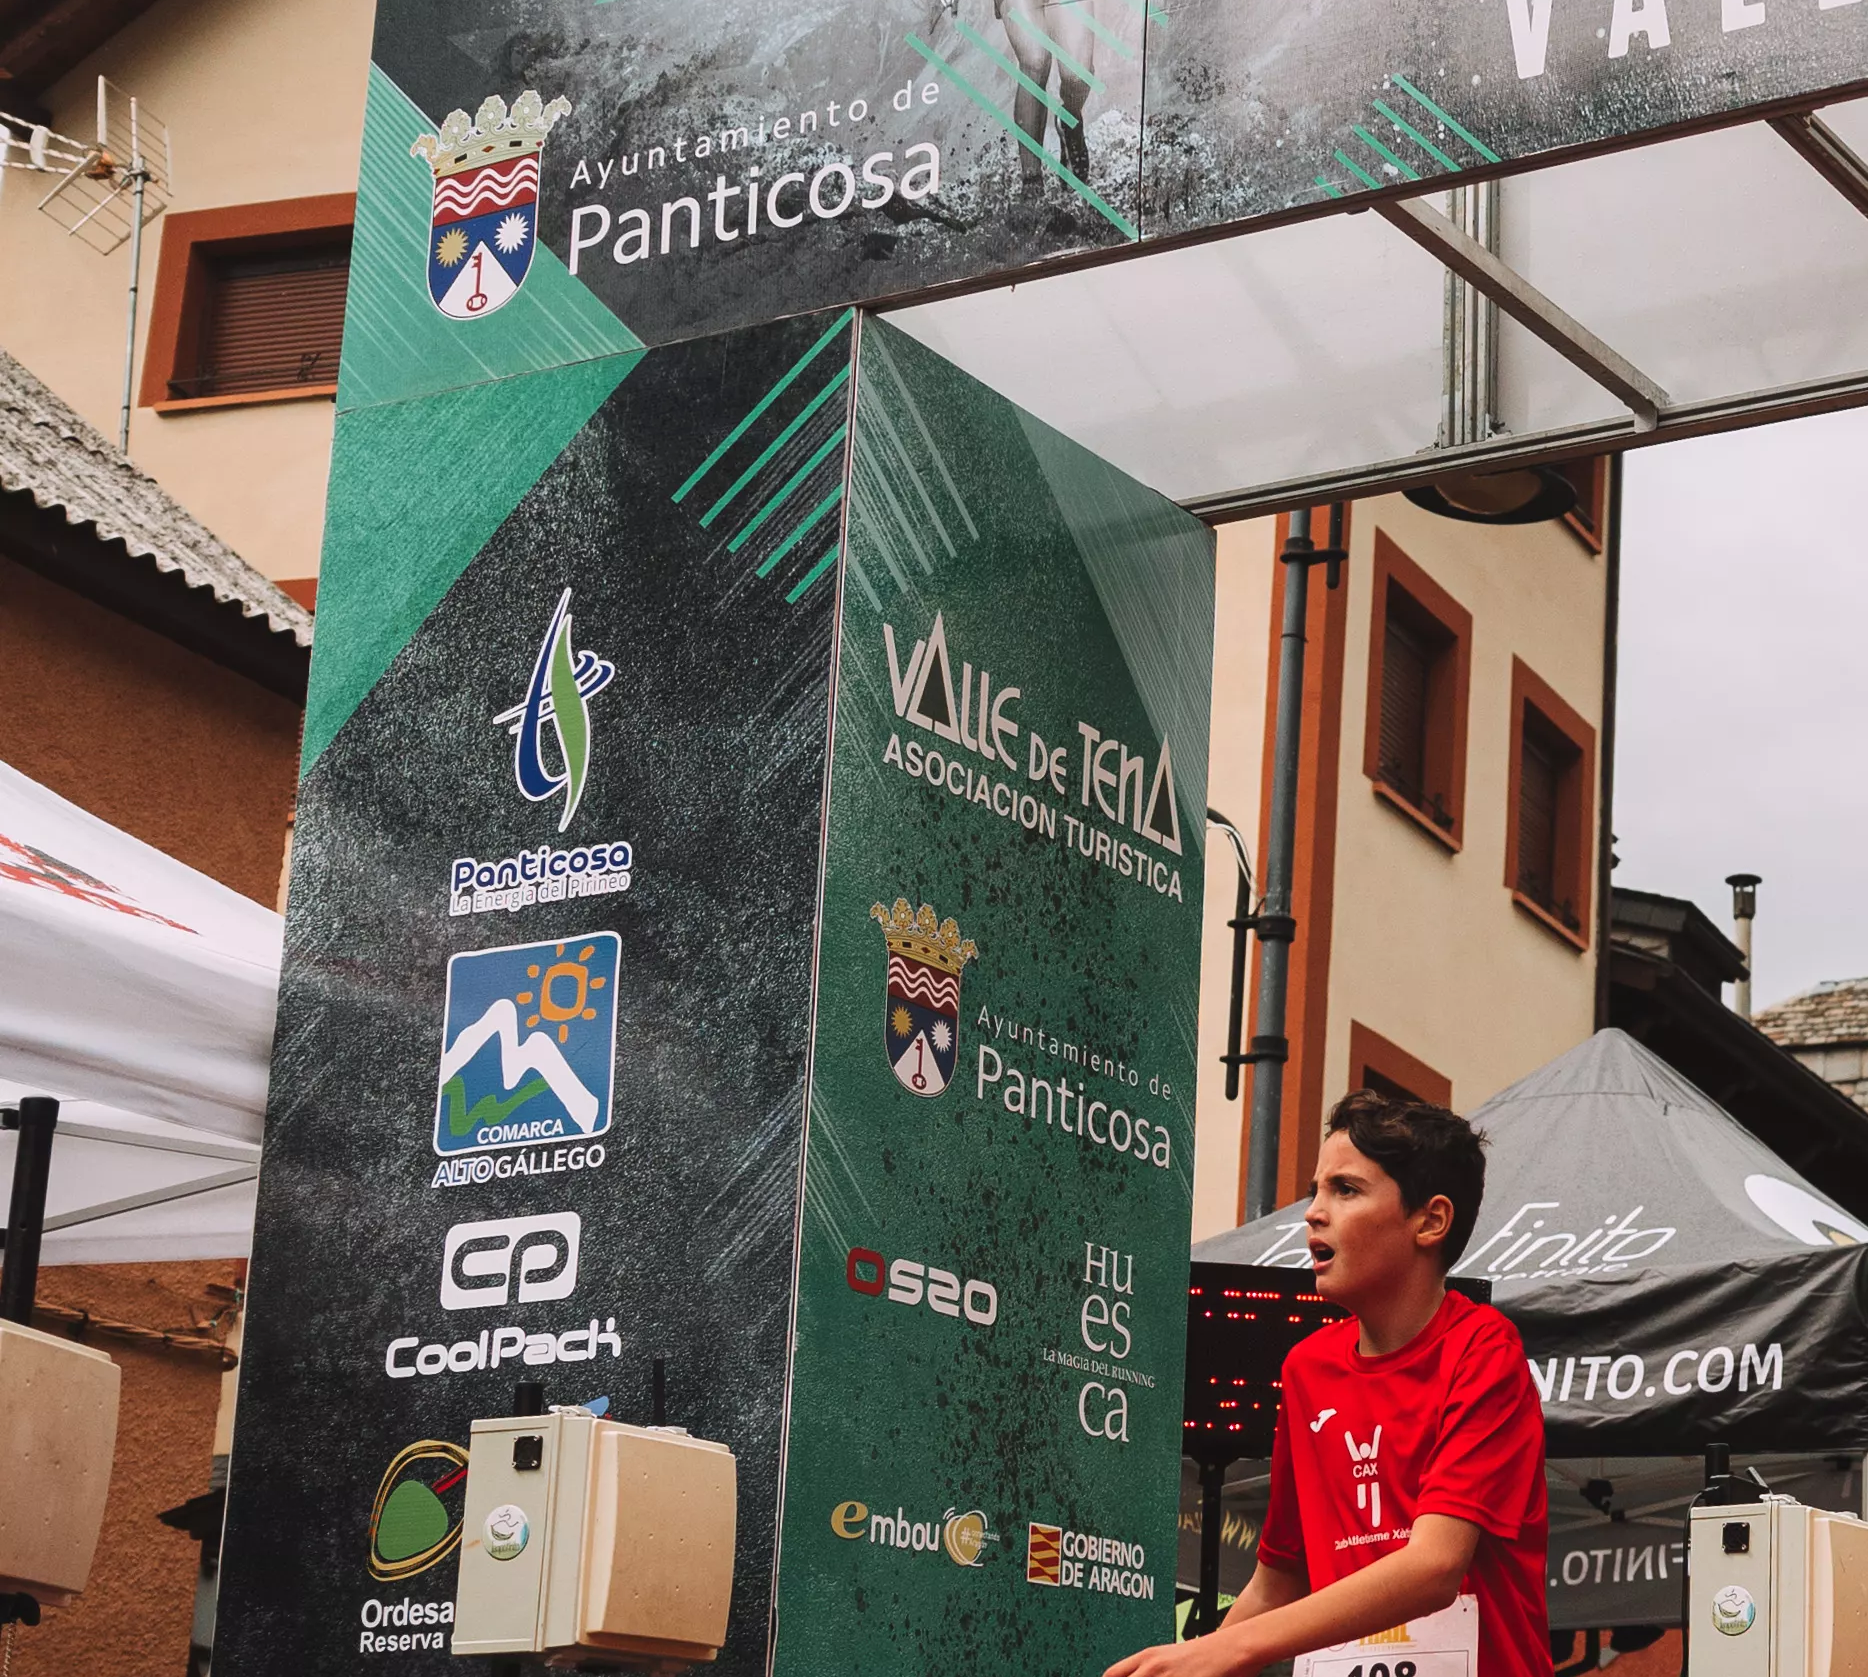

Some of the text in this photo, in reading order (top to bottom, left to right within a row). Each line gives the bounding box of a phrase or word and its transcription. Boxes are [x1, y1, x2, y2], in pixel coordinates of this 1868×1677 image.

[569, 79, 941, 191] Ayuntamiento de
[568, 140, 942, 276] Panticosa
[882, 733, 1184, 904] ASOCIACION TURISTICA
[452, 894, 469, 913] La
[540, 878, 565, 900] del
[570, 873, 628, 894] Pirineo
[453, 843, 631, 893] Panticosa
[977, 1005, 1172, 1101] Ayuntamiento de
[476, 1118, 565, 1145] COMARCA
[977, 1044, 1171, 1170] Panticosa
[385, 1316, 622, 1379] CoolPack
[1353, 1463, 1379, 1479] CAX
[830, 1500, 940, 1552] embou
[1062, 1530, 1145, 1570] GOBIERNO
[1061, 1559, 1154, 1601] DE ARAGON
[360, 1596, 455, 1629] Ordesa
[359, 1631, 445, 1654] Reserva
